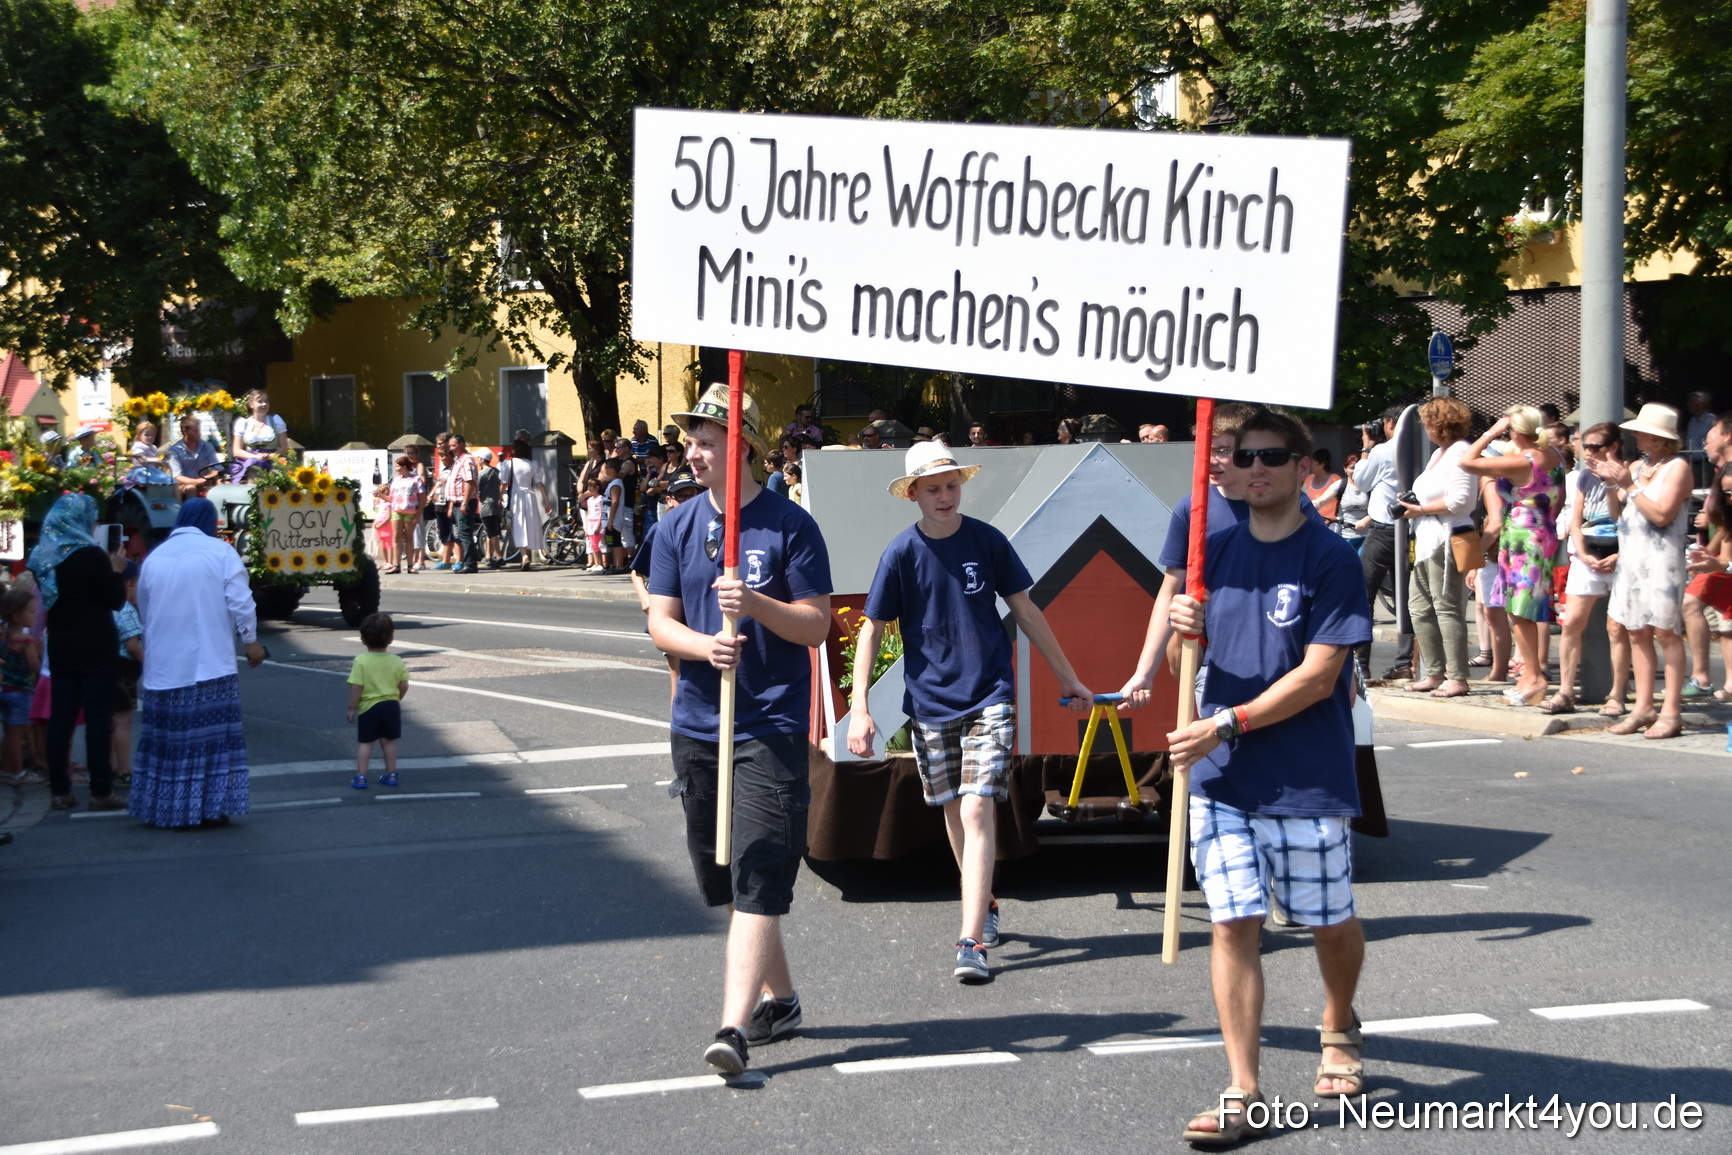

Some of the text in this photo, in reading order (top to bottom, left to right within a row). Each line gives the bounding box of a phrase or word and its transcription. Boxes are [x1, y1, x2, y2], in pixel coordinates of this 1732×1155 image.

[670, 135, 1294, 254] 50 Jahre Woffabecka Kirch
[697, 244, 1260, 382] Mini's machen's möglich
[267, 528, 343, 550] Rittershof
[288, 509, 332, 531] OGV
